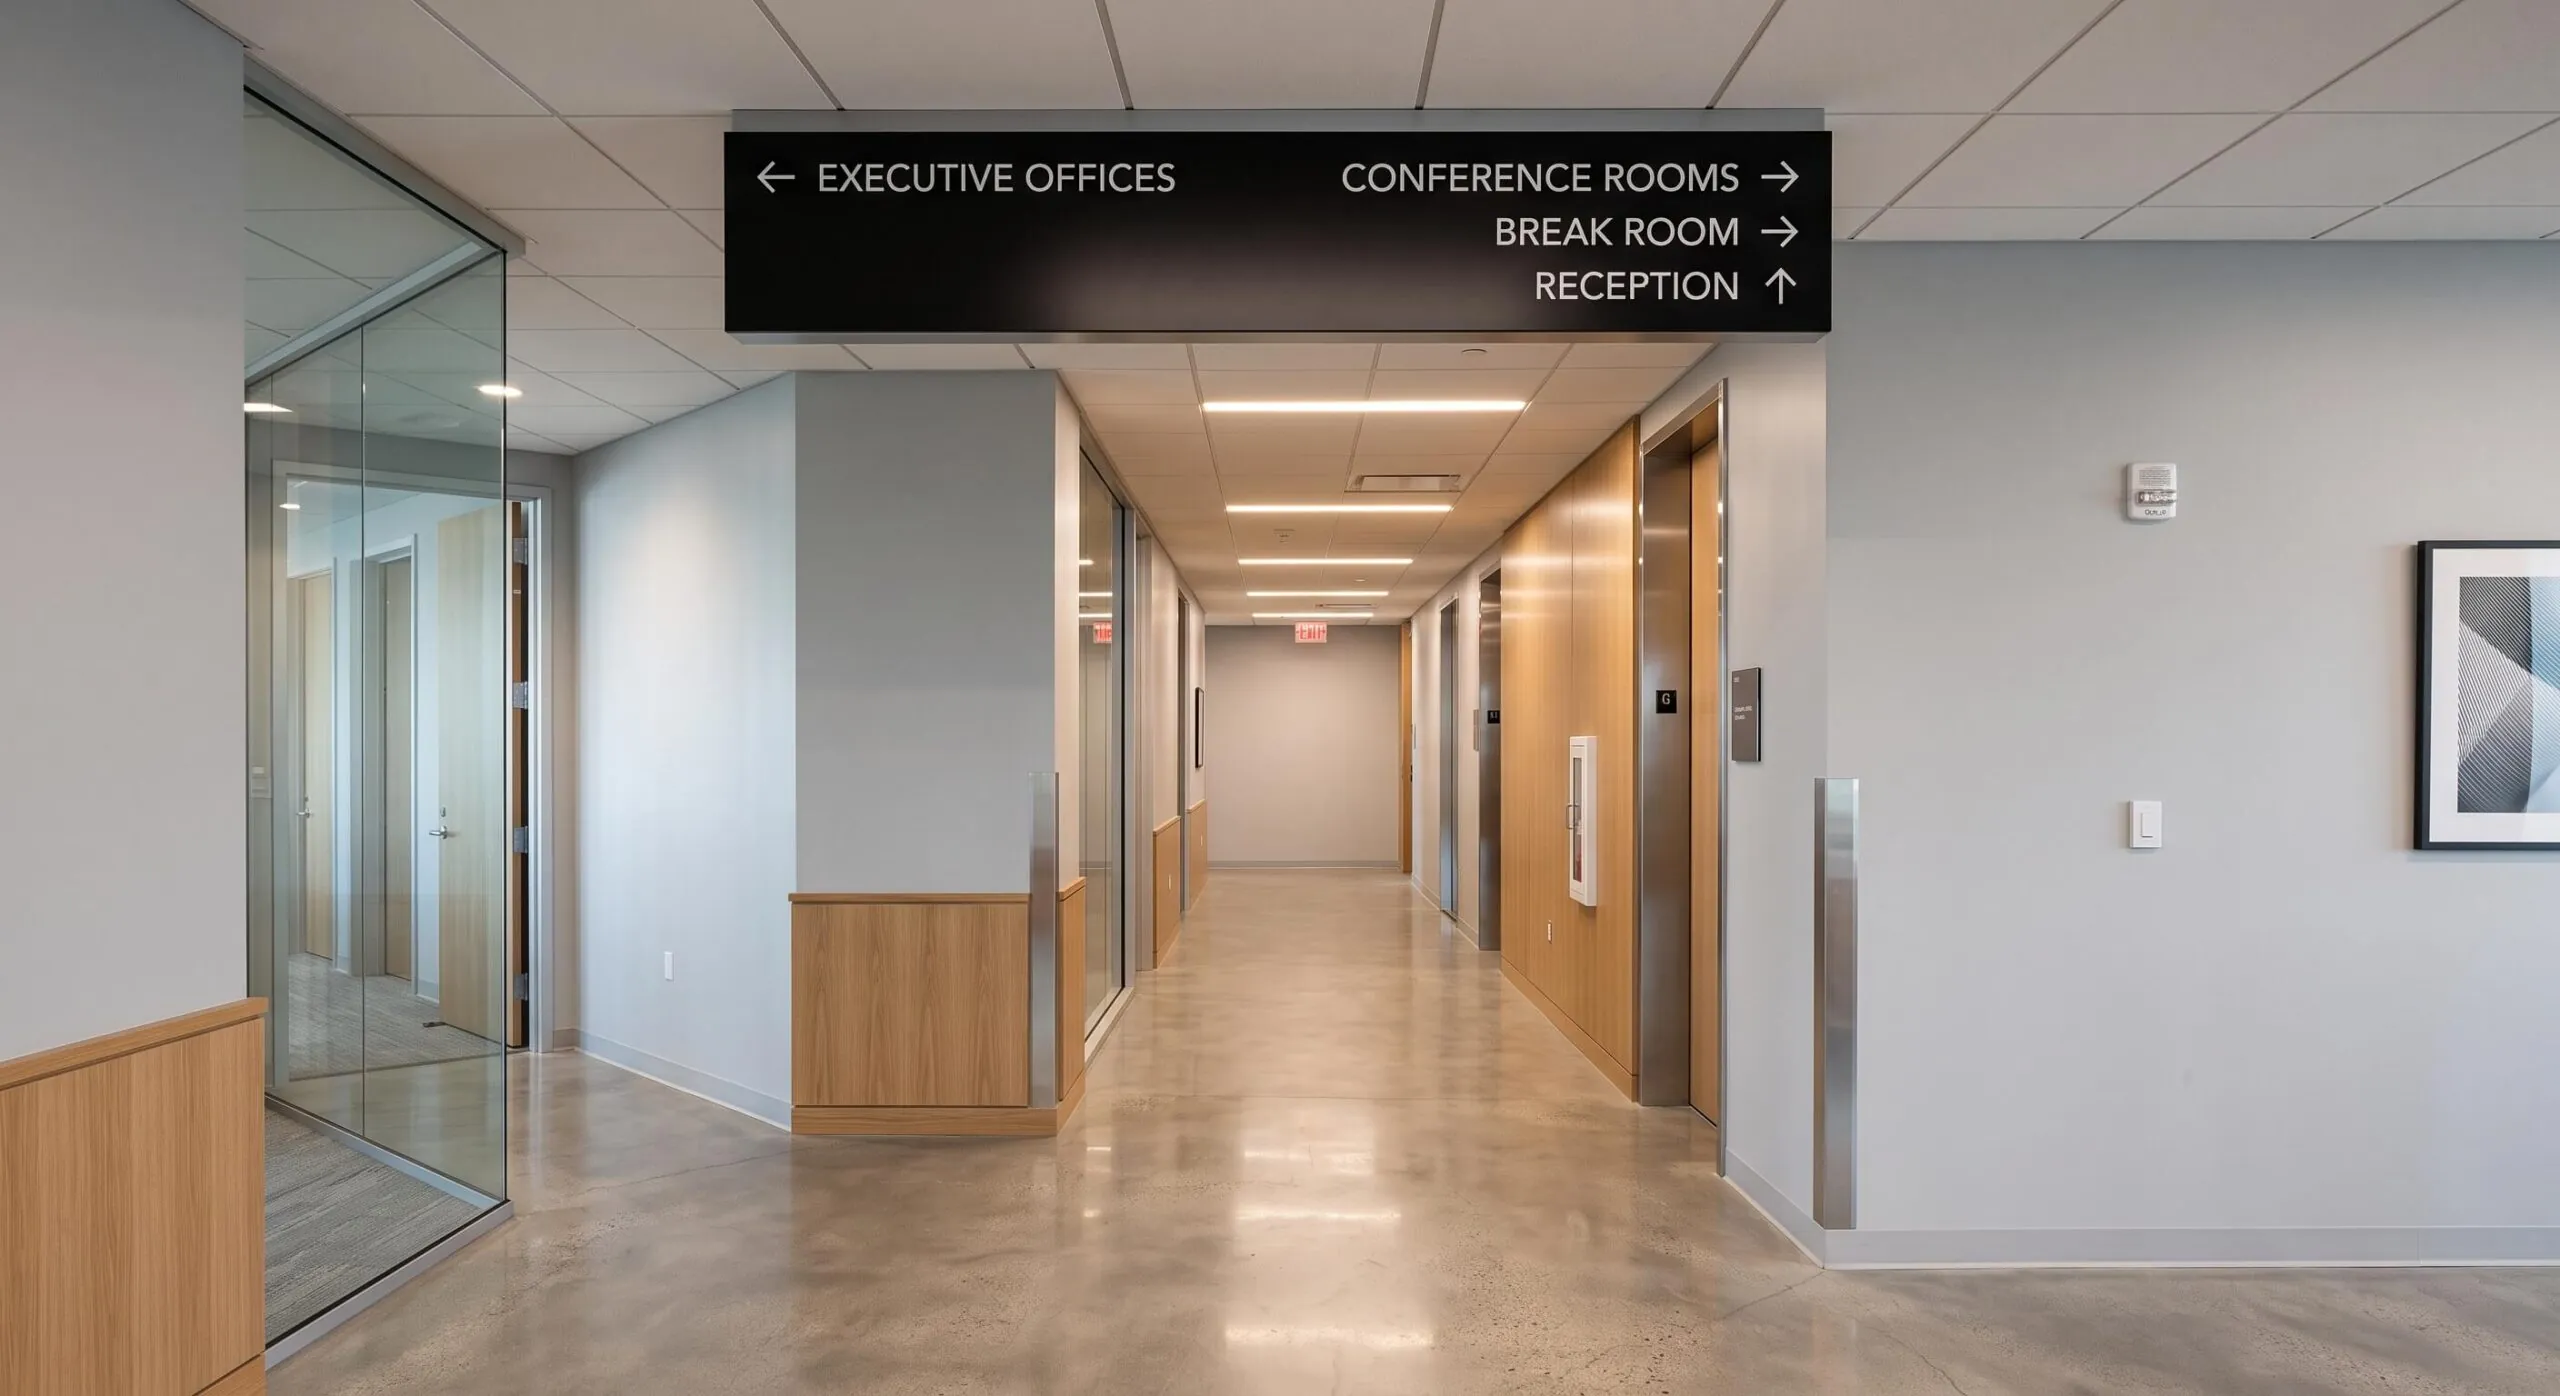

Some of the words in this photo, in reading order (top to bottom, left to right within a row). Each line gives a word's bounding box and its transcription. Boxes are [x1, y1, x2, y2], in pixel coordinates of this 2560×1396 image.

[819, 163, 1014, 193] EXECUTIVE
[1025, 163, 1176, 193] OFFICES
[1342, 163, 1592, 193] CONFERENCE
[1604, 163, 1739, 193] ROOMS
[1496, 217, 1613, 246] BREAK
[1625, 217, 1739, 247] ROOM
[1536, 271, 1738, 301] RECEPTION
[1661, 692, 1671, 705] G
